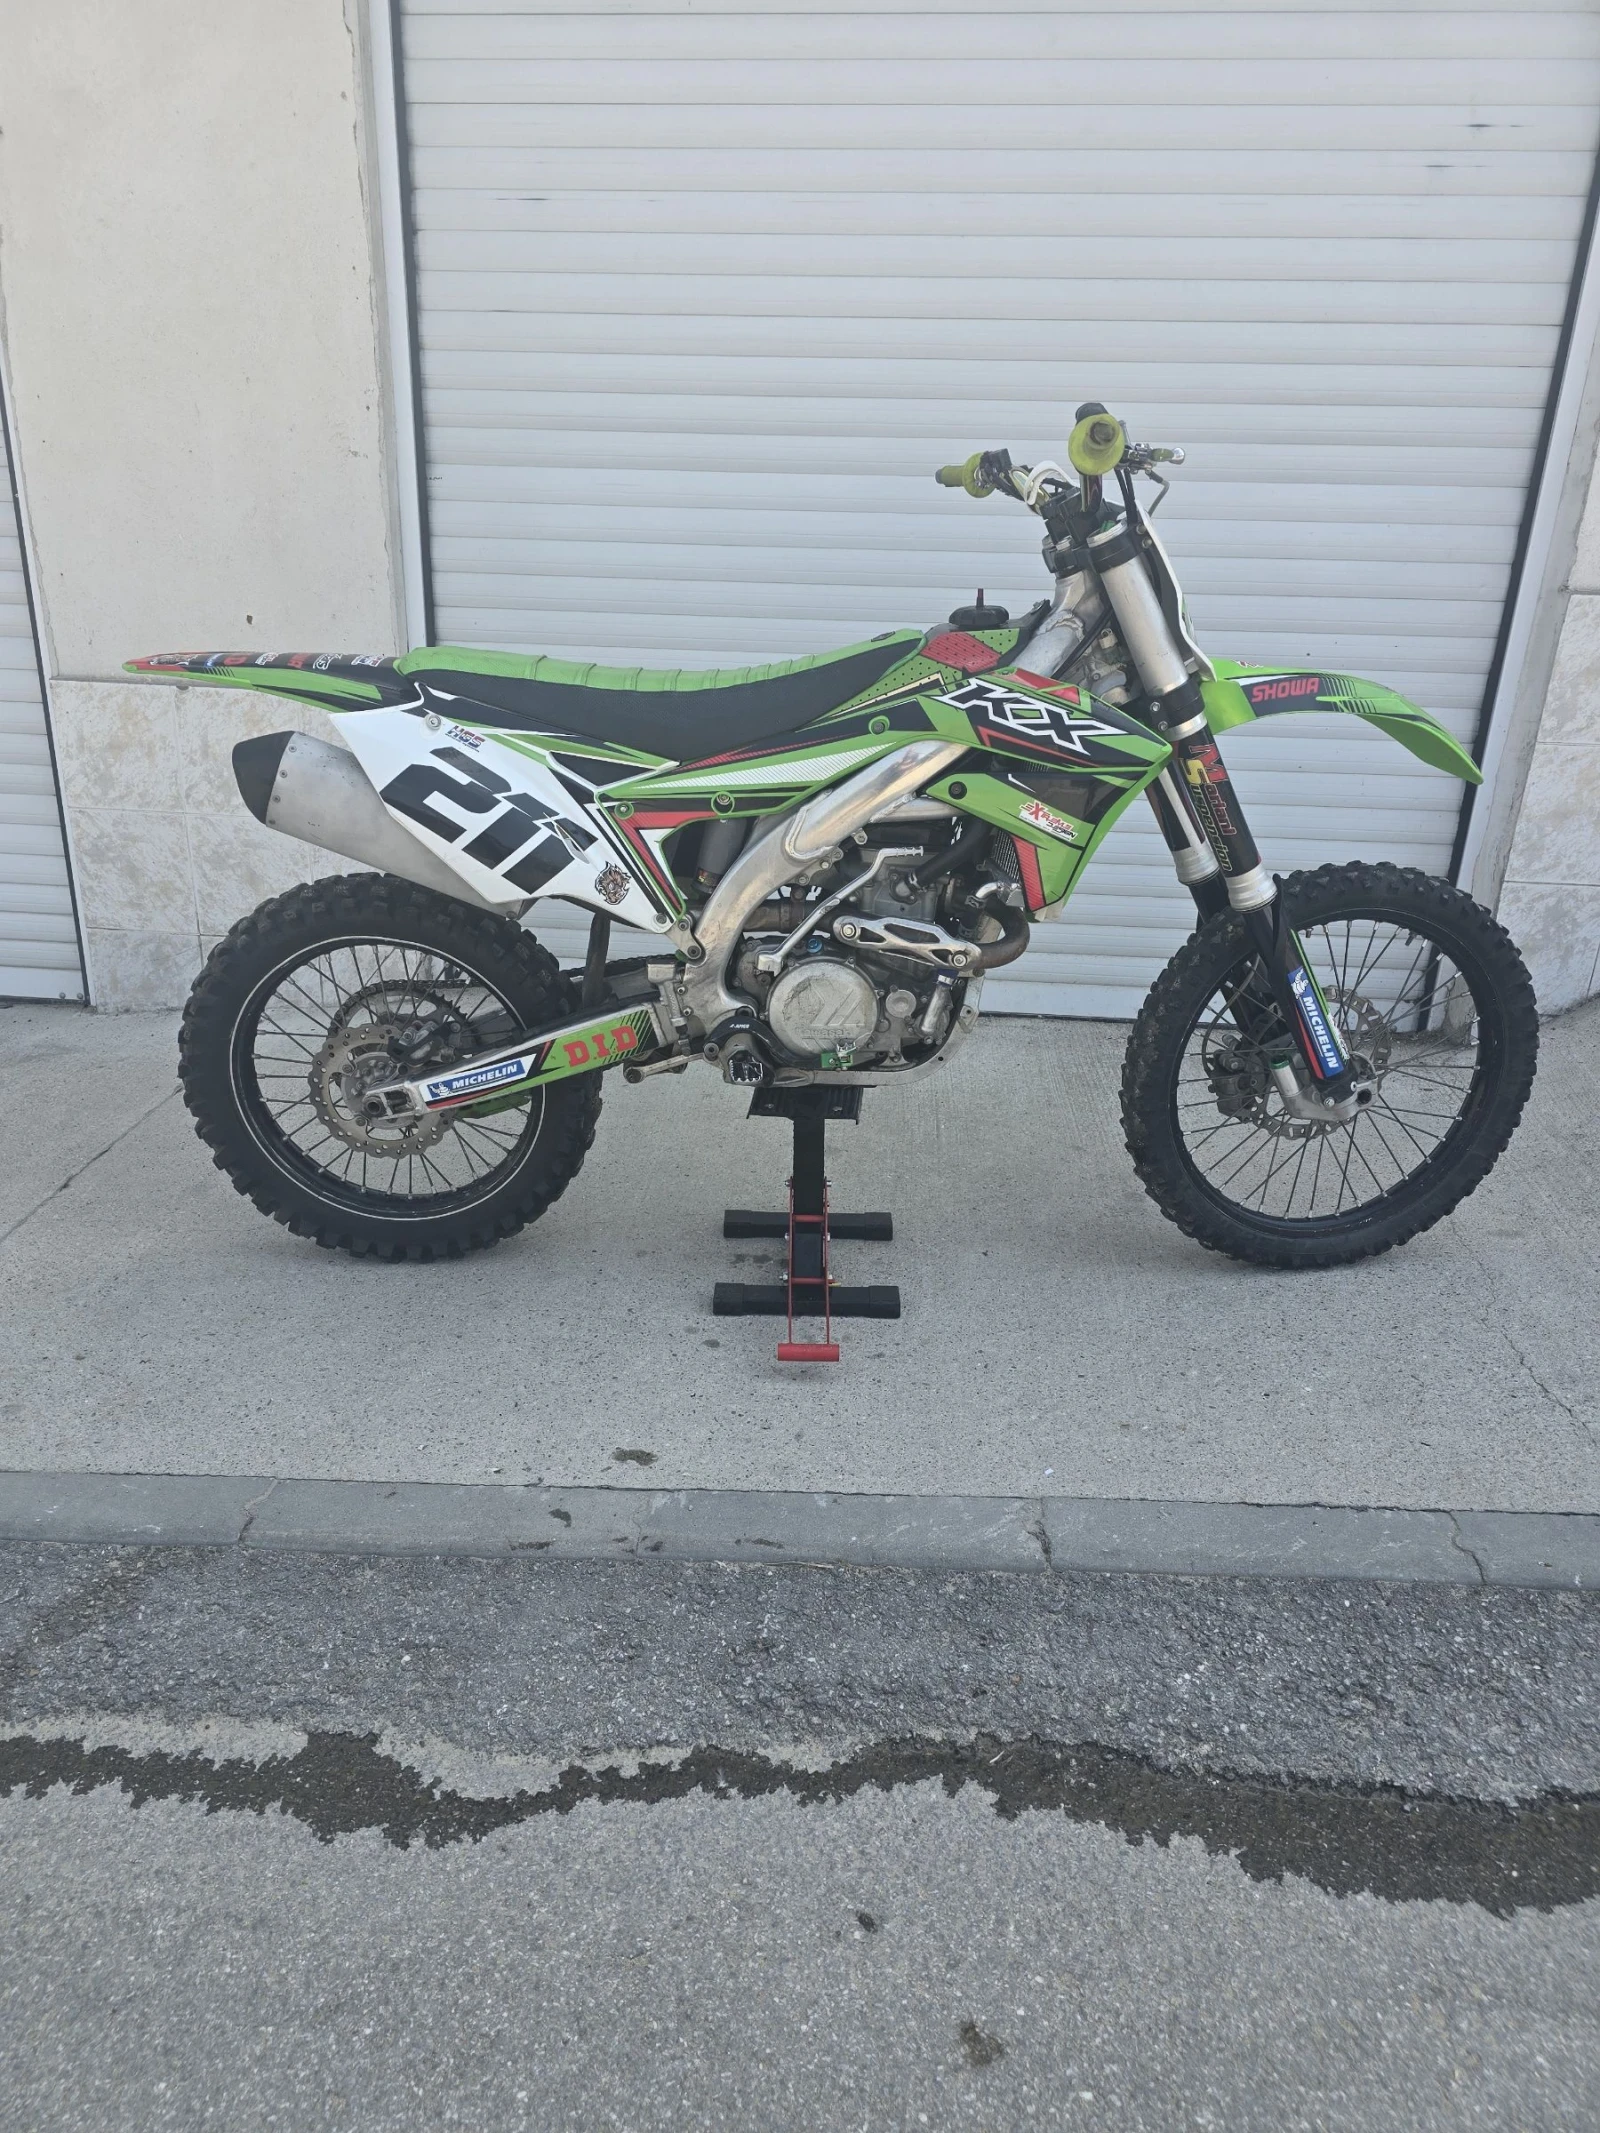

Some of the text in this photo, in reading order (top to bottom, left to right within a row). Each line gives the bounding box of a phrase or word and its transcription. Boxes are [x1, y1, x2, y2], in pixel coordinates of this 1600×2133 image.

[1251, 677, 1320, 703] SHOWA
[447, 725, 486, 749] HGS
[379, 746, 599, 896] 211
[1303, 996, 1340, 1069] MICHELIN
[452, 1064, 518, 1090] MICHELIN
